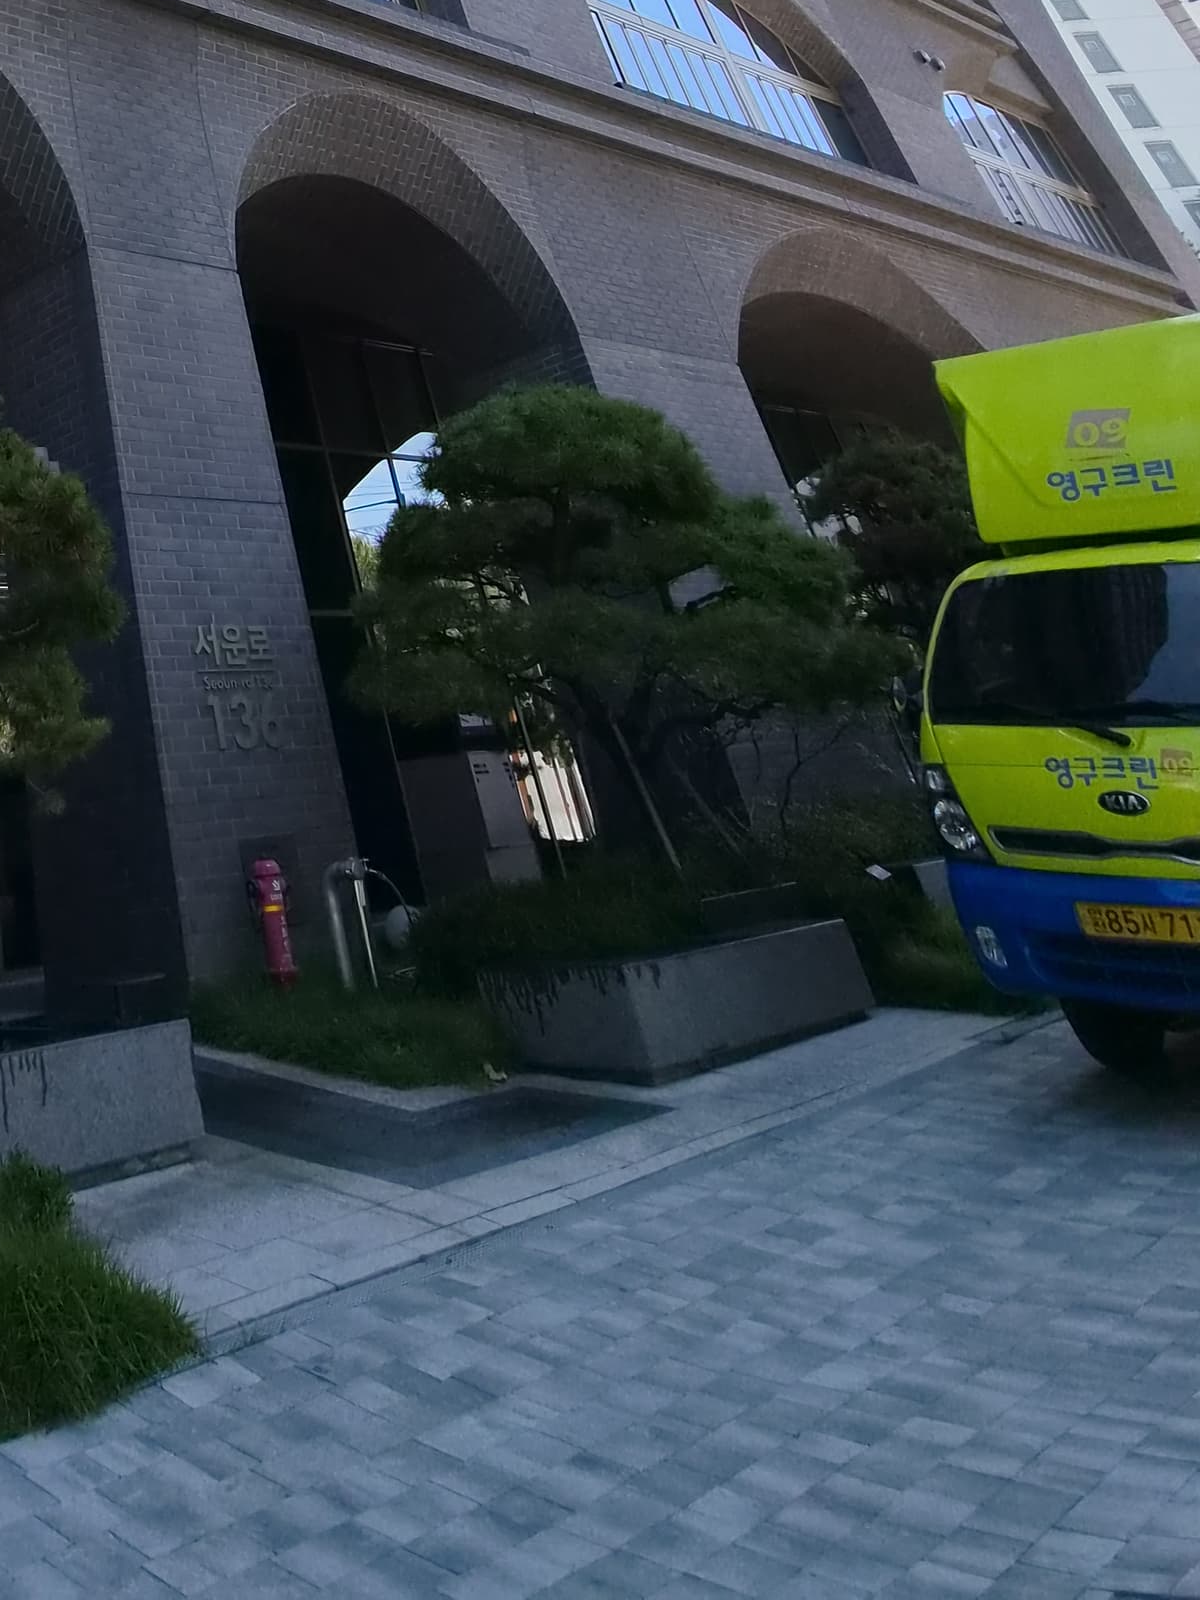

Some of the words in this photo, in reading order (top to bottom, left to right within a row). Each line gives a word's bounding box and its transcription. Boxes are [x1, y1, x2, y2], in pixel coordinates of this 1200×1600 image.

[1047, 459, 1177, 502] 영구크린
[195, 623, 273, 665] 서운로
[208, 694, 284, 751] 136
[1044, 757, 1159, 789] 영구크린
[1105, 794, 1142, 810] KIA
[1160, 911, 1200, 938] 71
